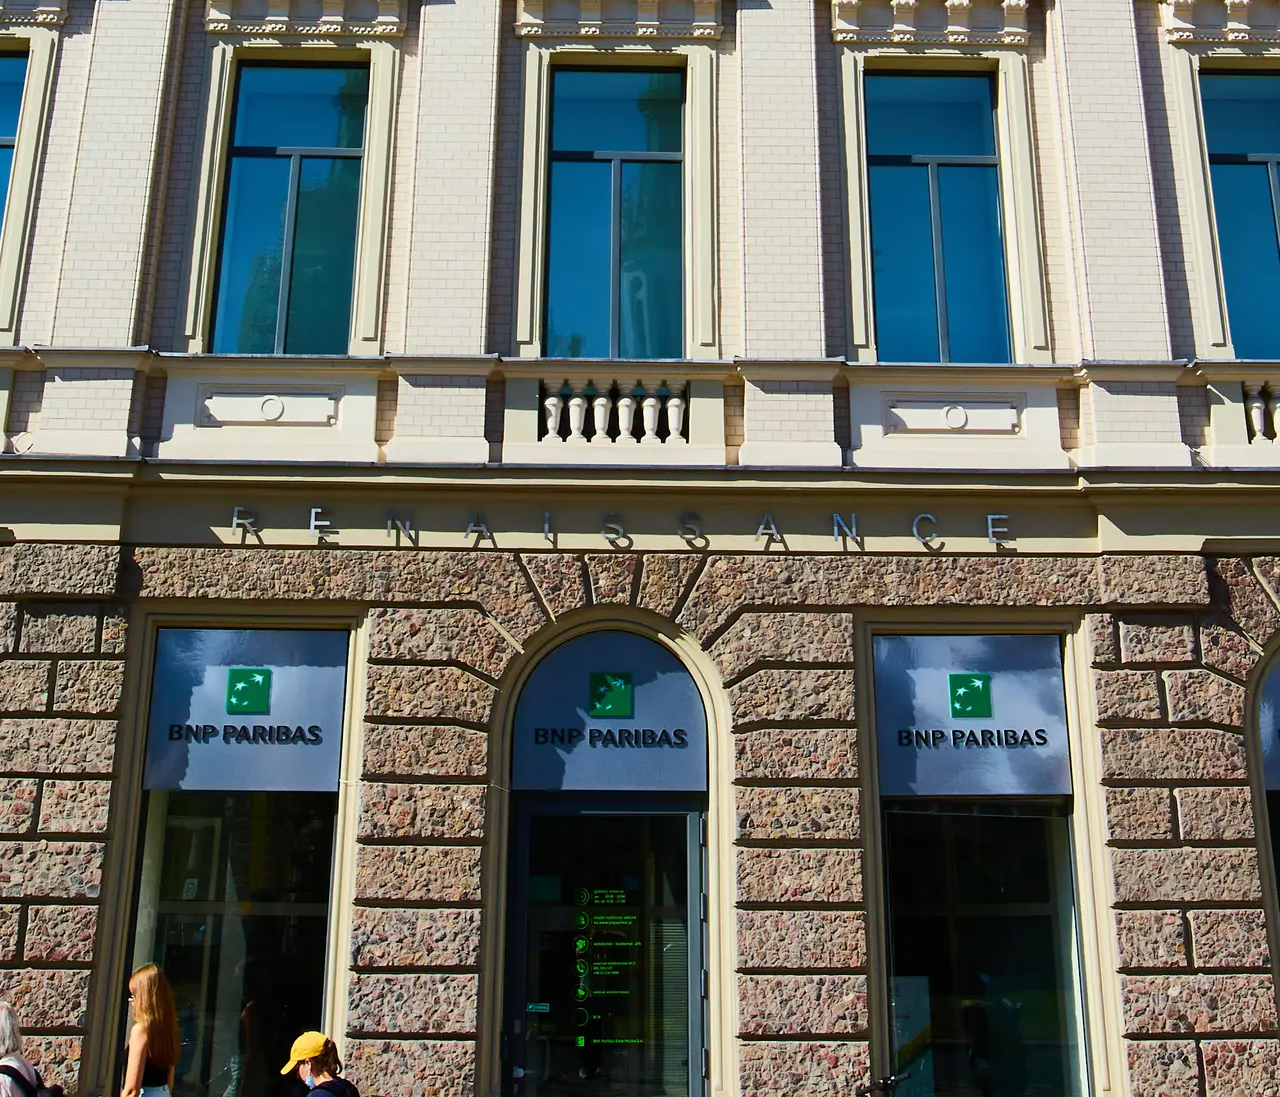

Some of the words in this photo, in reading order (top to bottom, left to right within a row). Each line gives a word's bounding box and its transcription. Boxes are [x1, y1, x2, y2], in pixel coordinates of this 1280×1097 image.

[231, 506, 1011, 545] RENAISSANCE
[169, 724, 218, 743] BNP
[223, 725, 322, 744] PARIBAS
[534, 728, 584, 745] BNP
[588, 728, 688, 747] PARIBAS
[898, 729, 946, 747] BNP
[951, 728, 1048, 747] PARIBAS
